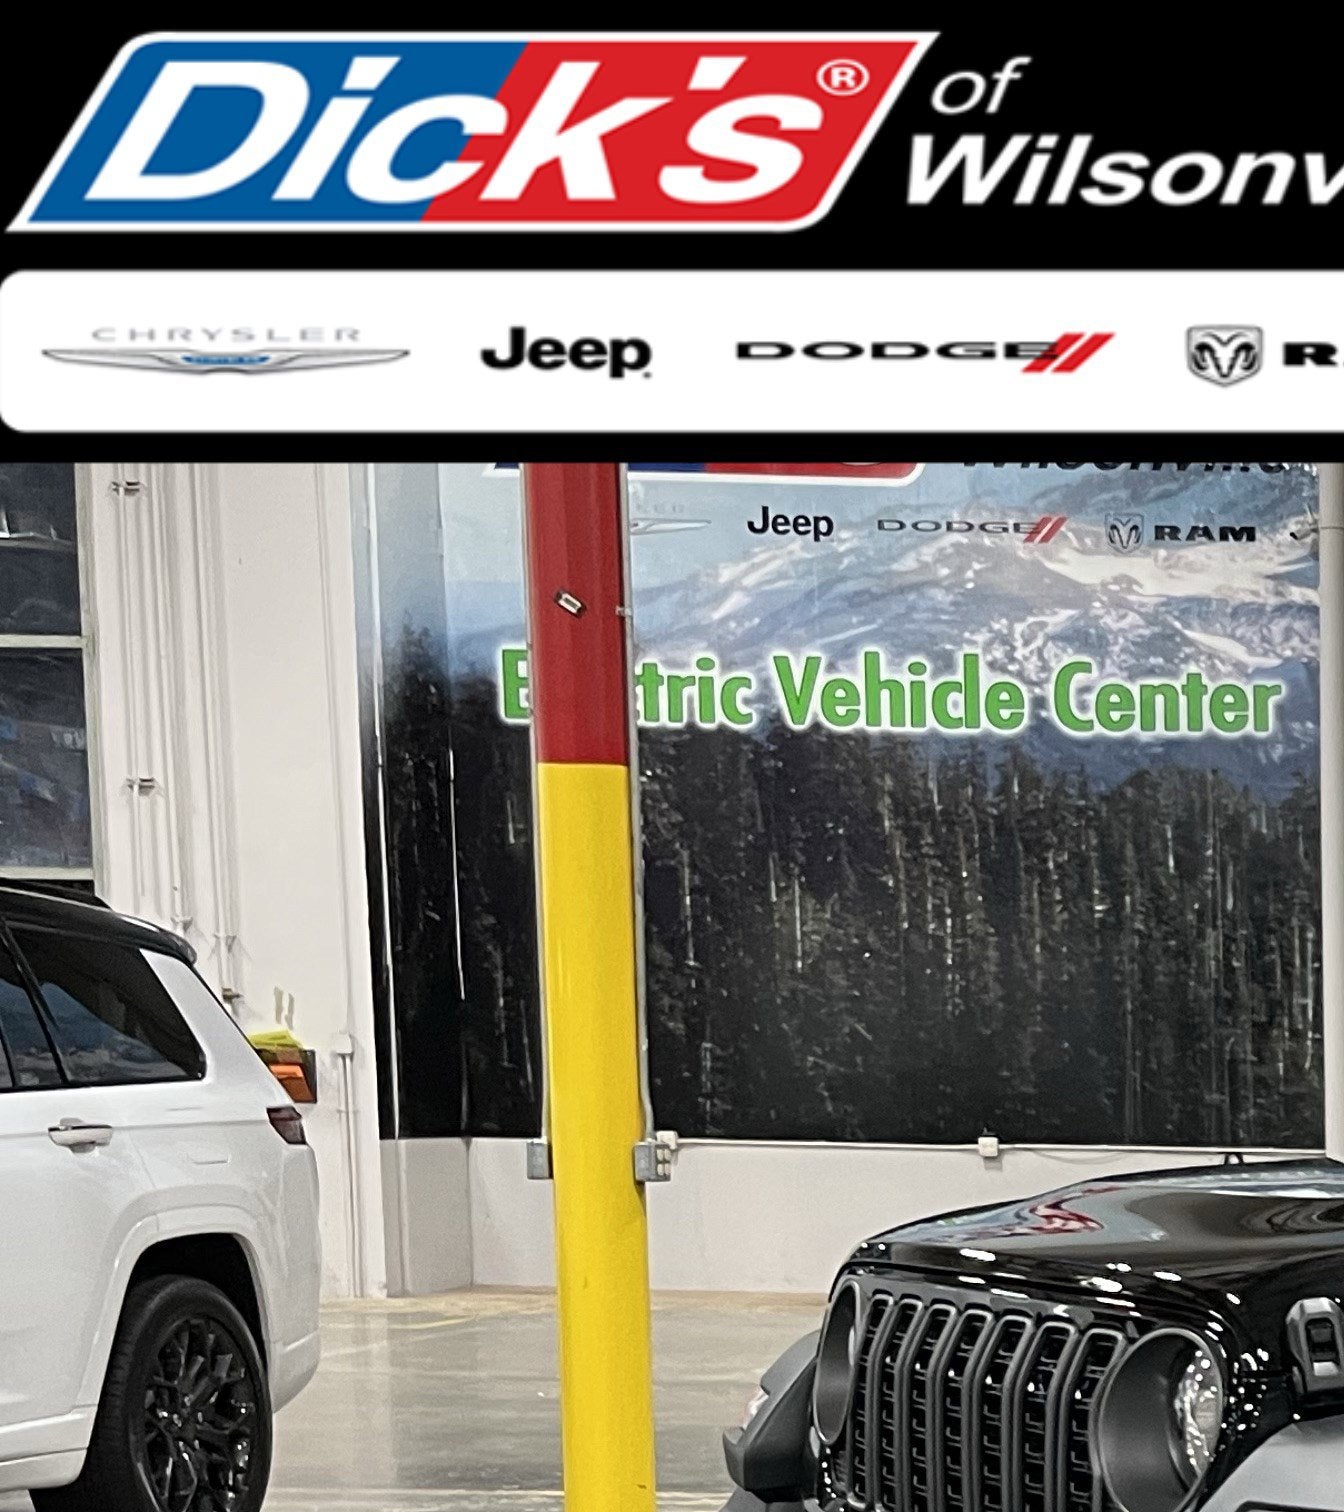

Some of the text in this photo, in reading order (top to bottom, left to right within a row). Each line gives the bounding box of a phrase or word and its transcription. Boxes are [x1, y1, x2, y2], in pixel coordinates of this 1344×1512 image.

[746, 505, 835, 543] Jeep
[877, 518, 1042, 534] DODGE
[1153, 523, 1258, 544] RAM
[502, 649, 1284, 732] Etric Vehicle Center
